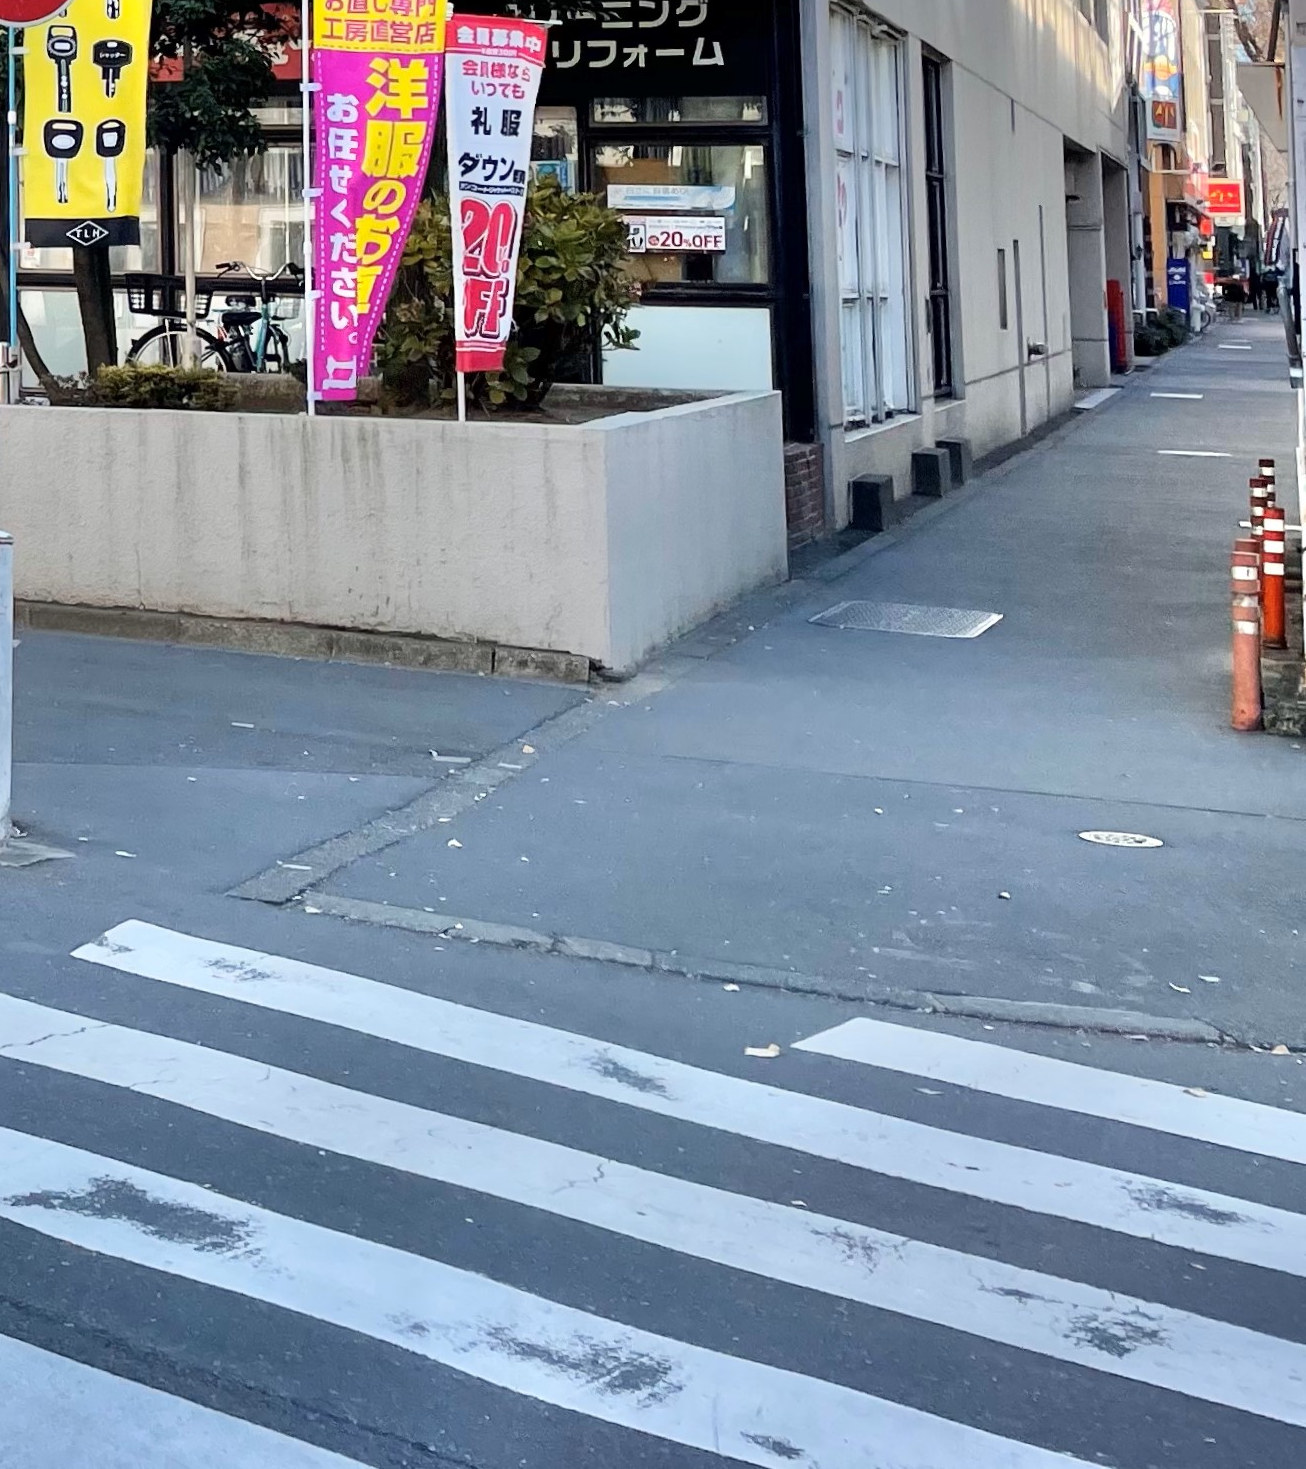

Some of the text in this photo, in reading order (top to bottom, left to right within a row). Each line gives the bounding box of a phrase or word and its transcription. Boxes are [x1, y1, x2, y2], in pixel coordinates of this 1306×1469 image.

[321, 17, 437, 45] 工房直営店
[552, 37, 724, 69] リフォーム
[470, 106, 522, 137] 礼服
[458, 151, 515, 182] ダウン
[76, 229, 101, 239] TLH
